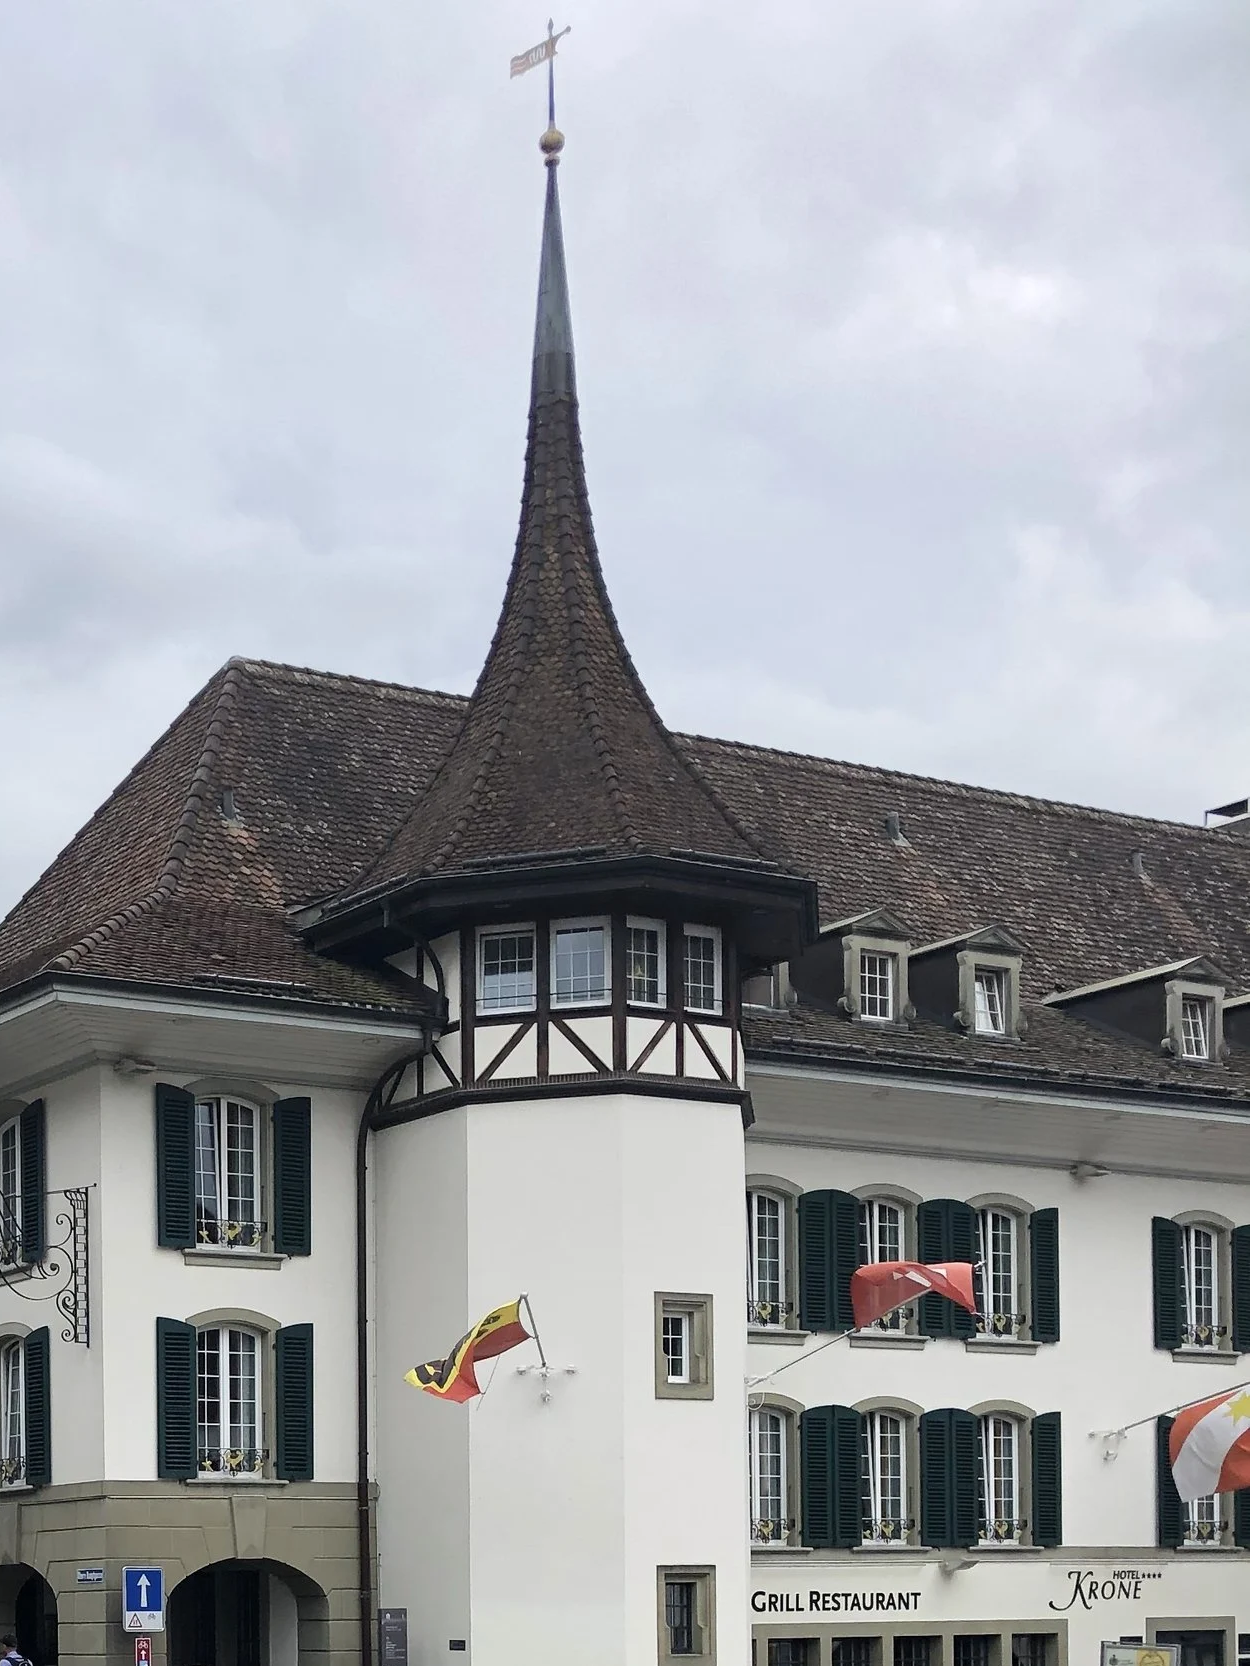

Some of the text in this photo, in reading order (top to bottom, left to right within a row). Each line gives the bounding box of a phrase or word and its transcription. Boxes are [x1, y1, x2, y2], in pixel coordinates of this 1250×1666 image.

[1113, 1570, 1140, 1580] HOTEL
[751, 1590, 922, 1613] GRILL RESTAURANT
[1049, 1571, 1142, 1611] KRONE
